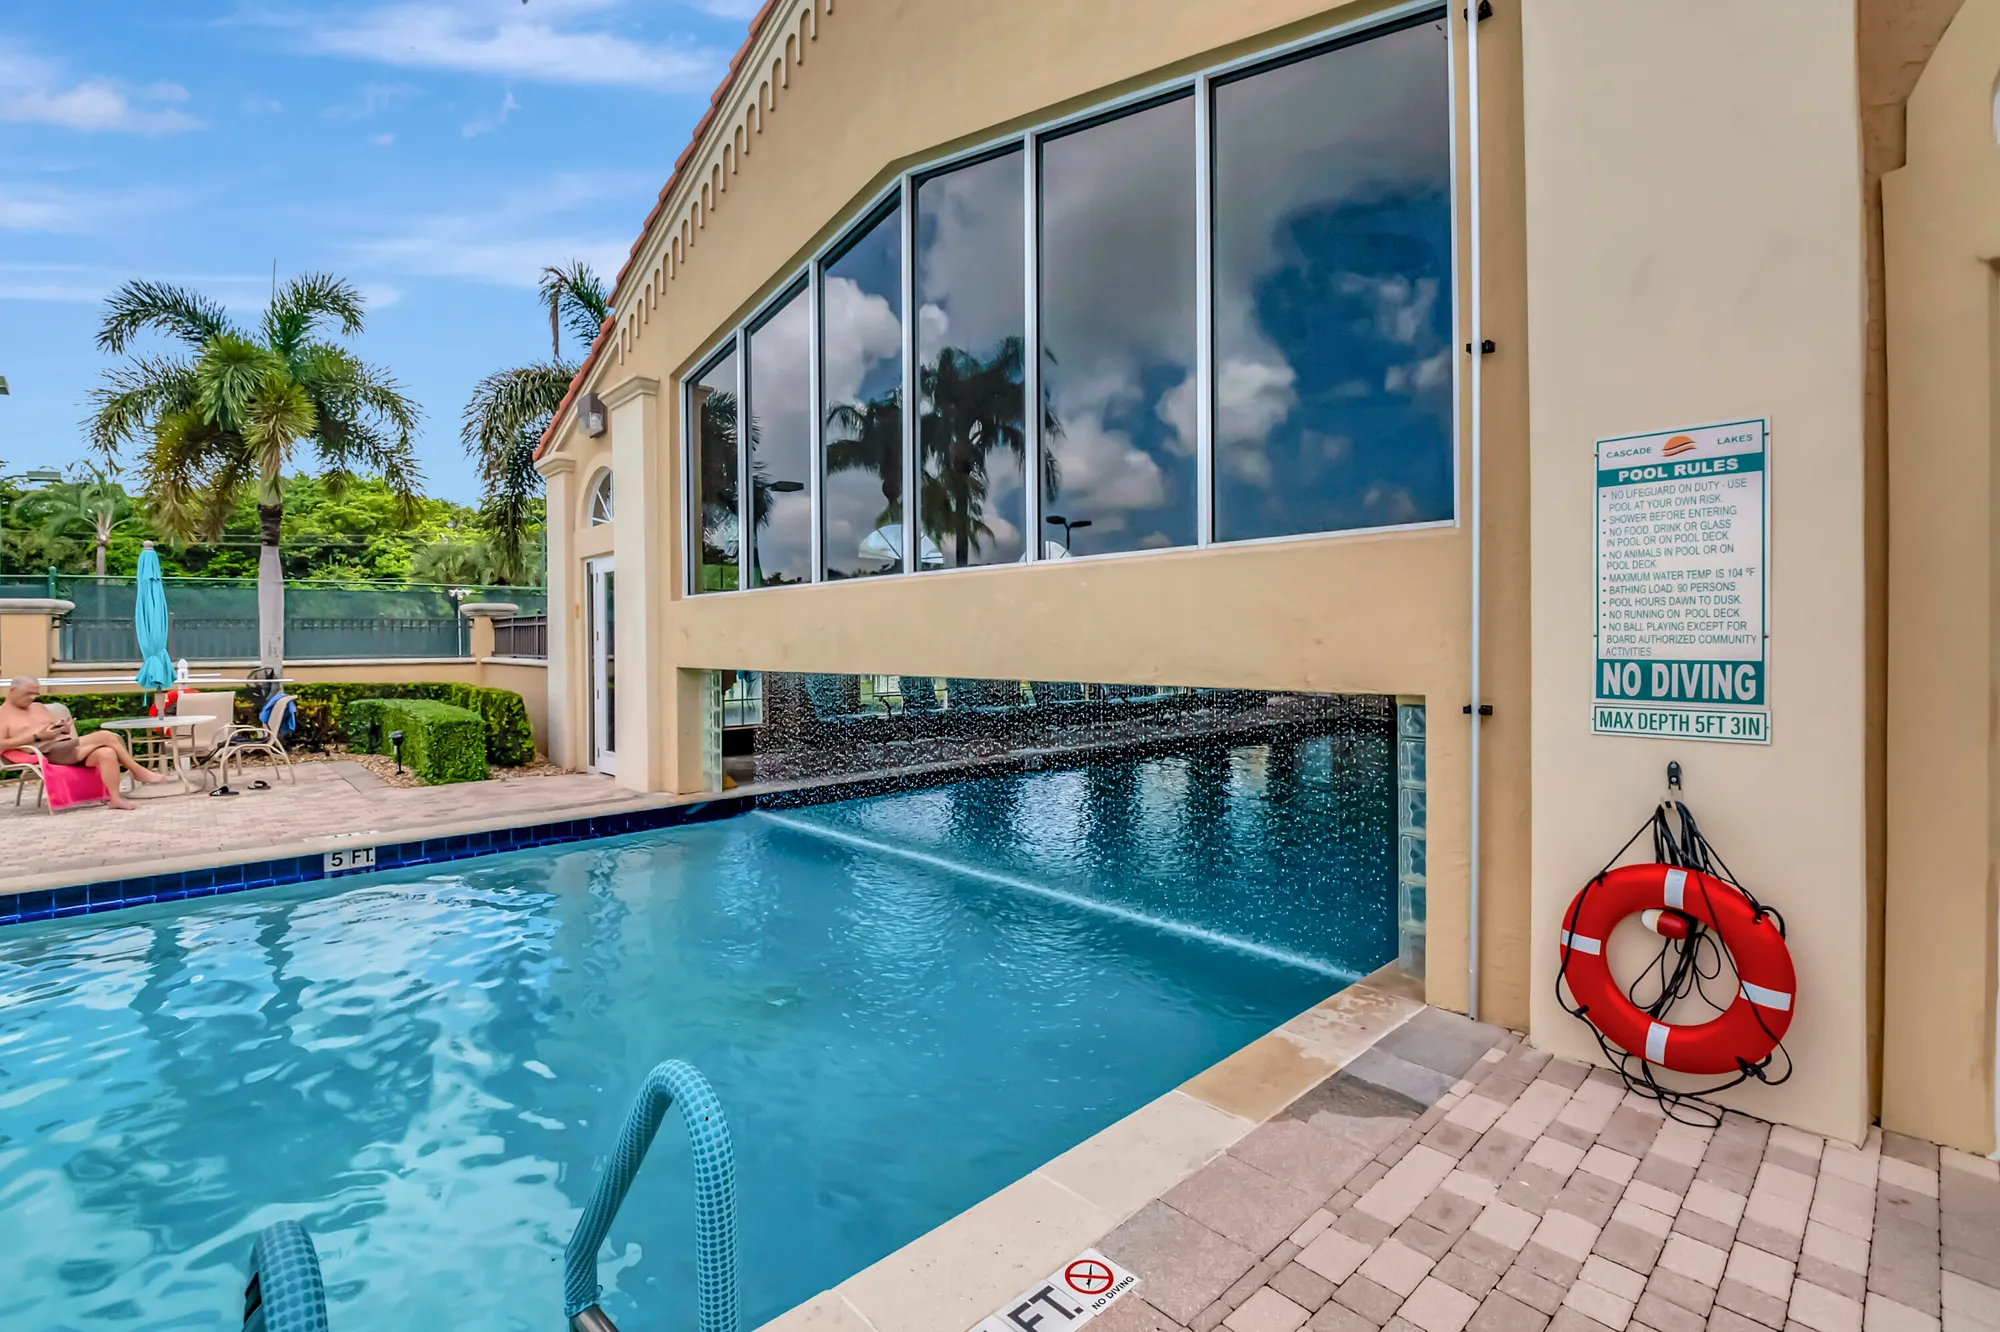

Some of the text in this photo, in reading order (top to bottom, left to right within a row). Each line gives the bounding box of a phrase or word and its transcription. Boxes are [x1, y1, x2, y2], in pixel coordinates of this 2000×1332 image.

[1606, 433, 1753, 459] CASCADE LAKES
[1618, 458, 1739, 482] POOL RULES
[1611, 490, 1624, 500] NO
[1626, 485, 1676, 499] LIFEGUARD
[1678, 483, 1692, 494] ON
[1694, 480, 1720, 493] DUTY
[1727, 478, 1747, 489] USE
[1609, 502, 1632, 512] POOL
[1634, 500, 1645, 509] AT
[1646, 498, 1672, 509] YOUR
[1674, 496, 1697, 507] OWN
[1609, 513, 1647, 525] SHOWER
[1649, 509, 1686, 521] BEFORE
[1609, 527, 1622, 537] NO
[1653, 523, 1681, 534] DRINK
[1683, 521, 1698, 532] OR
[1700, 519, 1732, 531] GLASS
[1607, 538, 1615, 547] IN
[1617, 537, 1641, 547] POOL
[1643, 535, 1656, 546] OR
[1658, 534, 1673, 545] ON
[1674, 533, 1699, 543] POOL
[1609, 543, 1735, 560] NO ANIMALS IN POOL OR ON
[1606, 560, 1630, 570] POOL
[1609, 573, 1651, 583] MAXIMUM
[1653, 570, 1684, 581] WATER
[1715, 568, 1725, 579] IS
[1728, 567, 1743, 578] 104
[1609, 584, 1646, 594] BATHING
[1677, 583, 1688, 593] 90
[1609, 597, 1633, 607] POOL
[1635, 596, 1666, 607] HOURS
[1668, 595, 1697, 606] DAWN
[1698, 595, 1711, 605] TO
[1609, 610, 1622, 619] NO
[1624, 609, 1665, 619] RUNNING
[1666, 608, 1681, 619] ON
[1685, 608, 1711, 618] POOL
[1608, 620, 1748, 632] NO BALL PLAYING EXCEPT FOR
[1606, 634, 1758, 644] BOARD AUTHORIZED COMMUNITY
[1602, 662, 1757, 701] NO DIVING
[1599, 711, 1760, 736] MAX DEPTH 5FT 3IN
[331, 847, 374, 868] 5 FT.
[1091, 1275, 1135, 1311] NO DIVING
[1006, 1284, 1085, 1332] FT.
